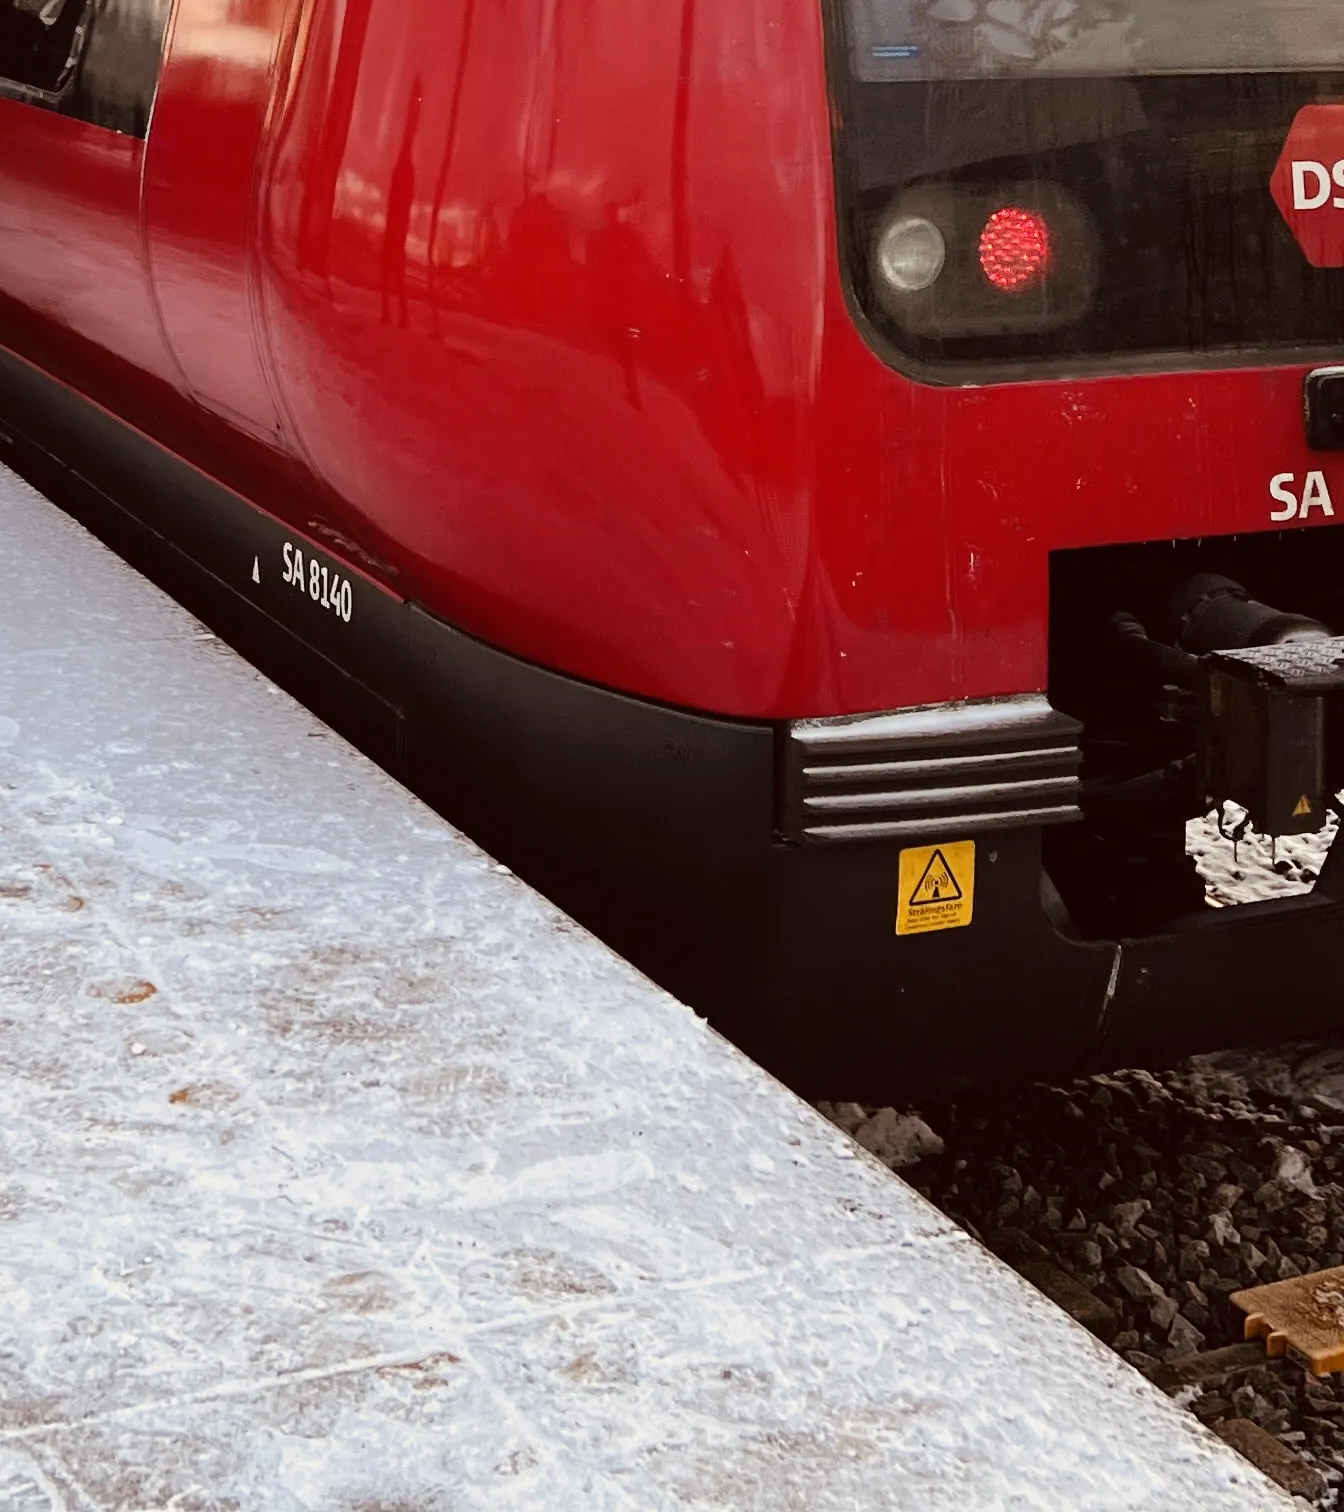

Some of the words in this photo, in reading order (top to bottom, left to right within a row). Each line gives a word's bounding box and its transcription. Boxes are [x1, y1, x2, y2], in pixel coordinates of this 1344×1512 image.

[1268, 470, 1335, 521] SA
[282, 541, 306, 593] SA
[308, 558, 353, 623] 8140
